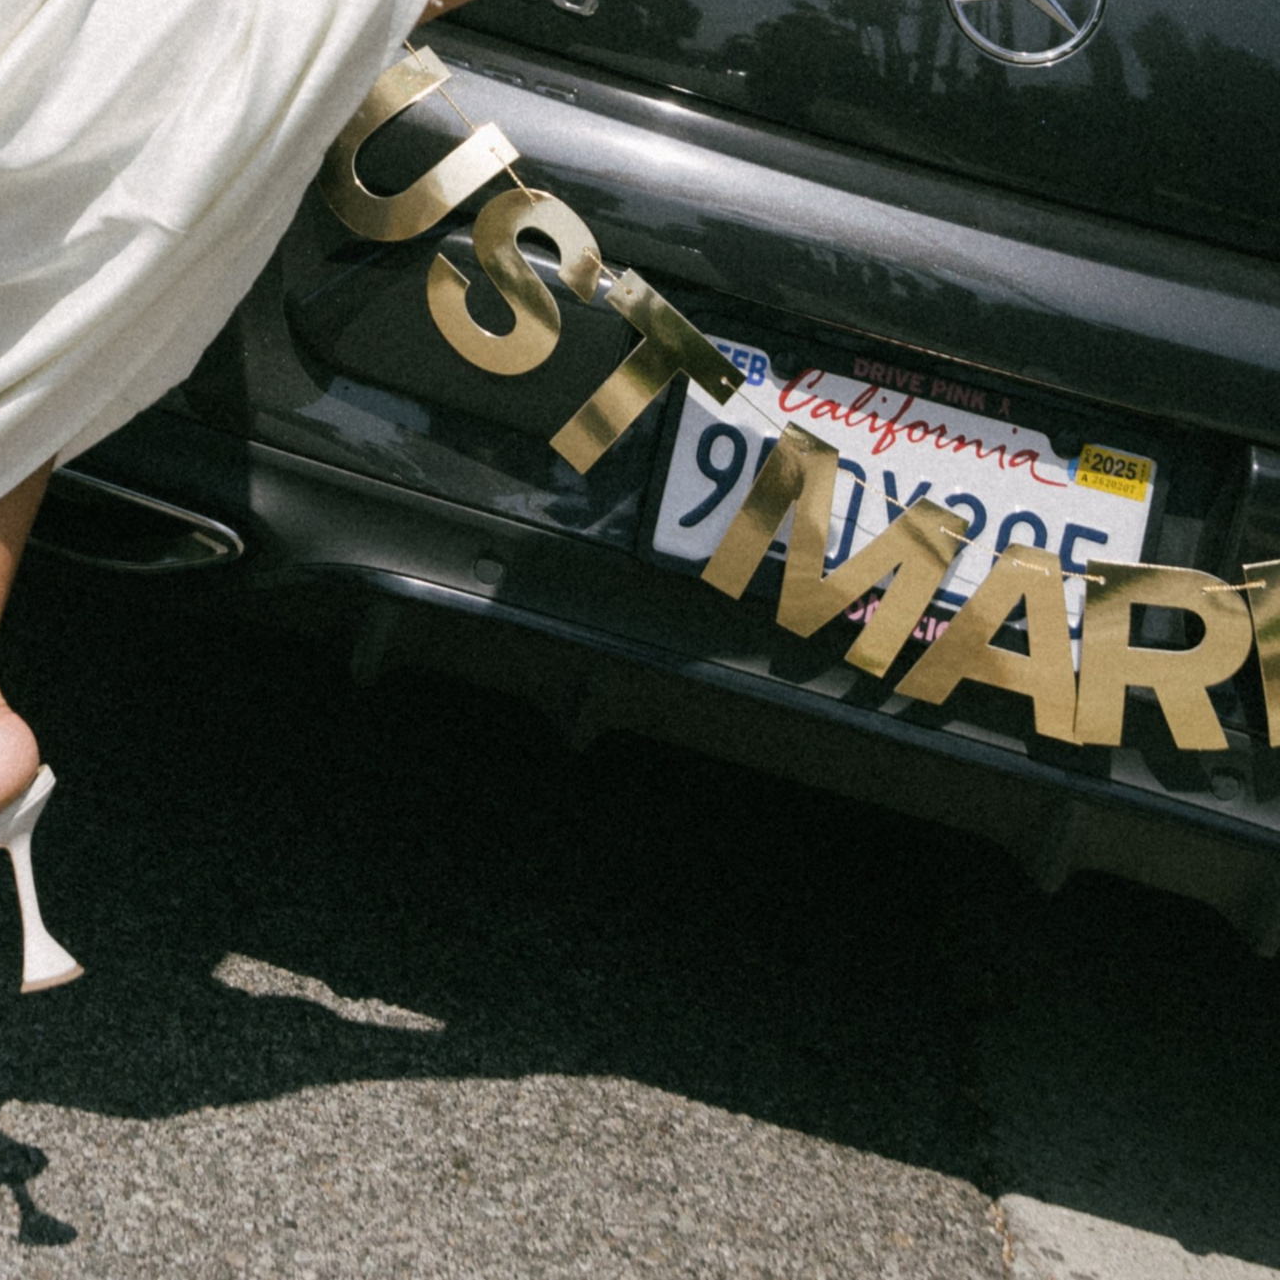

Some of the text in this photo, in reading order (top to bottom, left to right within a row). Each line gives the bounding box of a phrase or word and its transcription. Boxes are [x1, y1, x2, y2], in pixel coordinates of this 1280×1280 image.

[852, 356, 986, 411] DRIVE PINK
[778, 368, 1068, 487] California
[1090, 452, 1138, 481] 2025
[701, 420, 1280, 751] MAR
